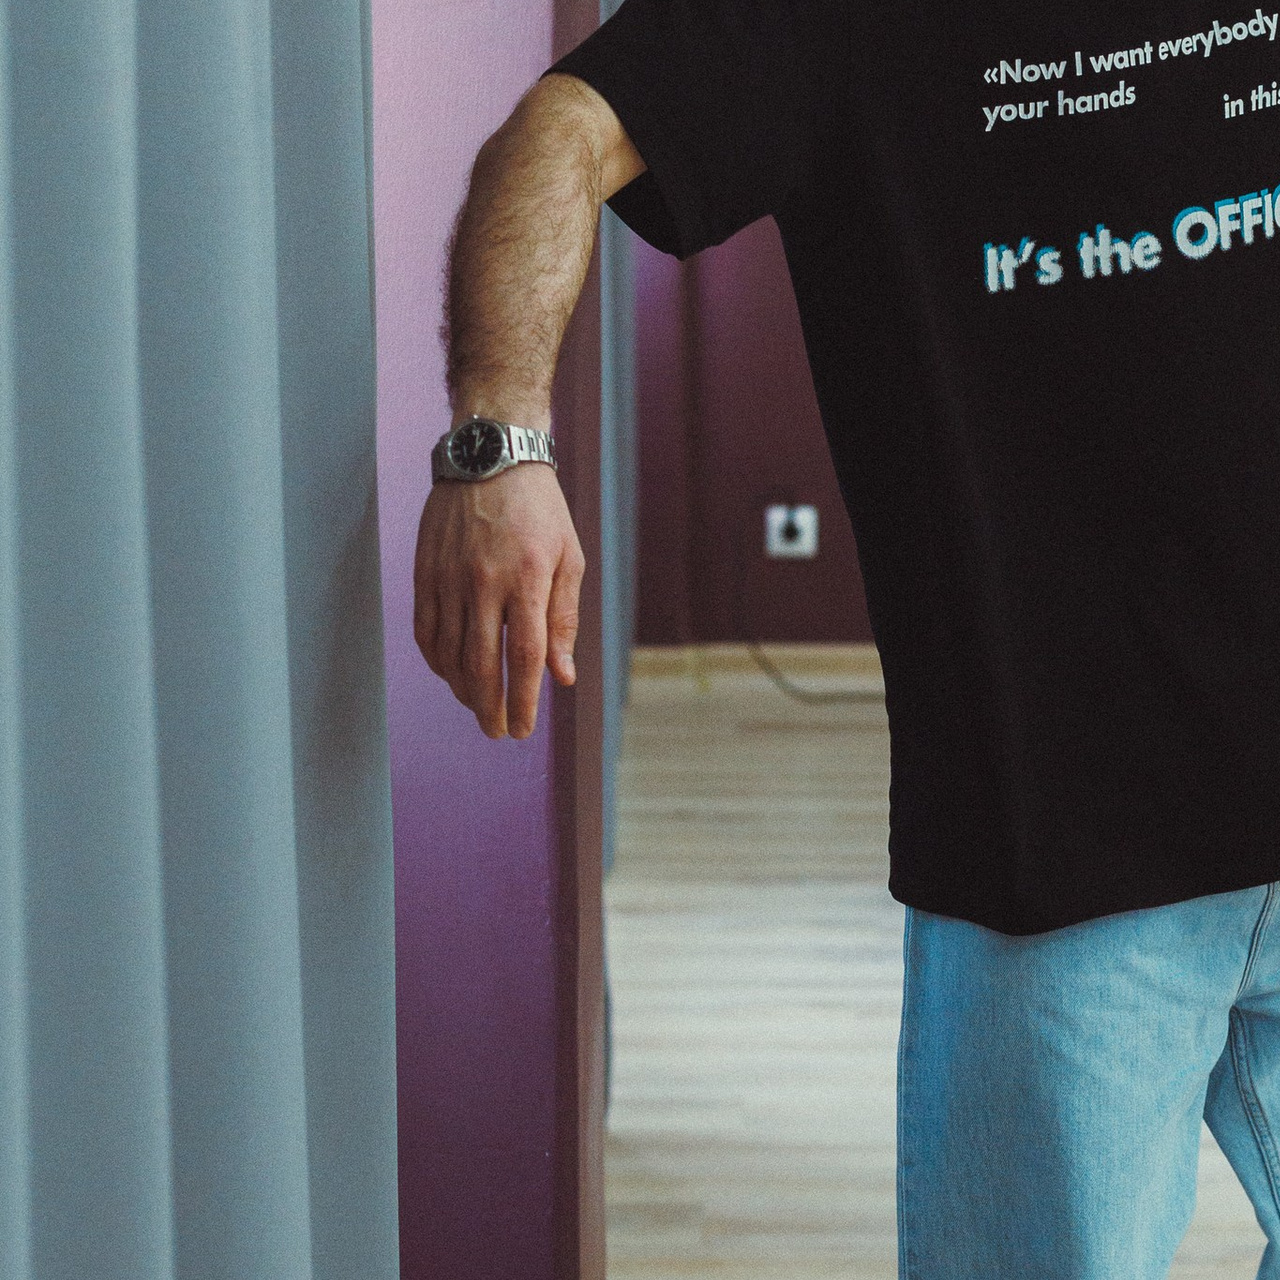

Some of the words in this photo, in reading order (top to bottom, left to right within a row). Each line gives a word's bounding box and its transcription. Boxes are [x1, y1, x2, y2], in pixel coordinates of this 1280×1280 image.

[984, 59, 1067, 85] «Now
[1075, 51, 1083, 77] I
[1089, 41, 1154, 73] want
[1158, 9, 1279, 60] everybody
[982, 101, 1049, 132] your
[1058, 81, 1137, 115] hands
[1223, 94, 1245, 118] in
[984, 237, 1064, 292] It's
[1077, 224, 1163, 278] the
